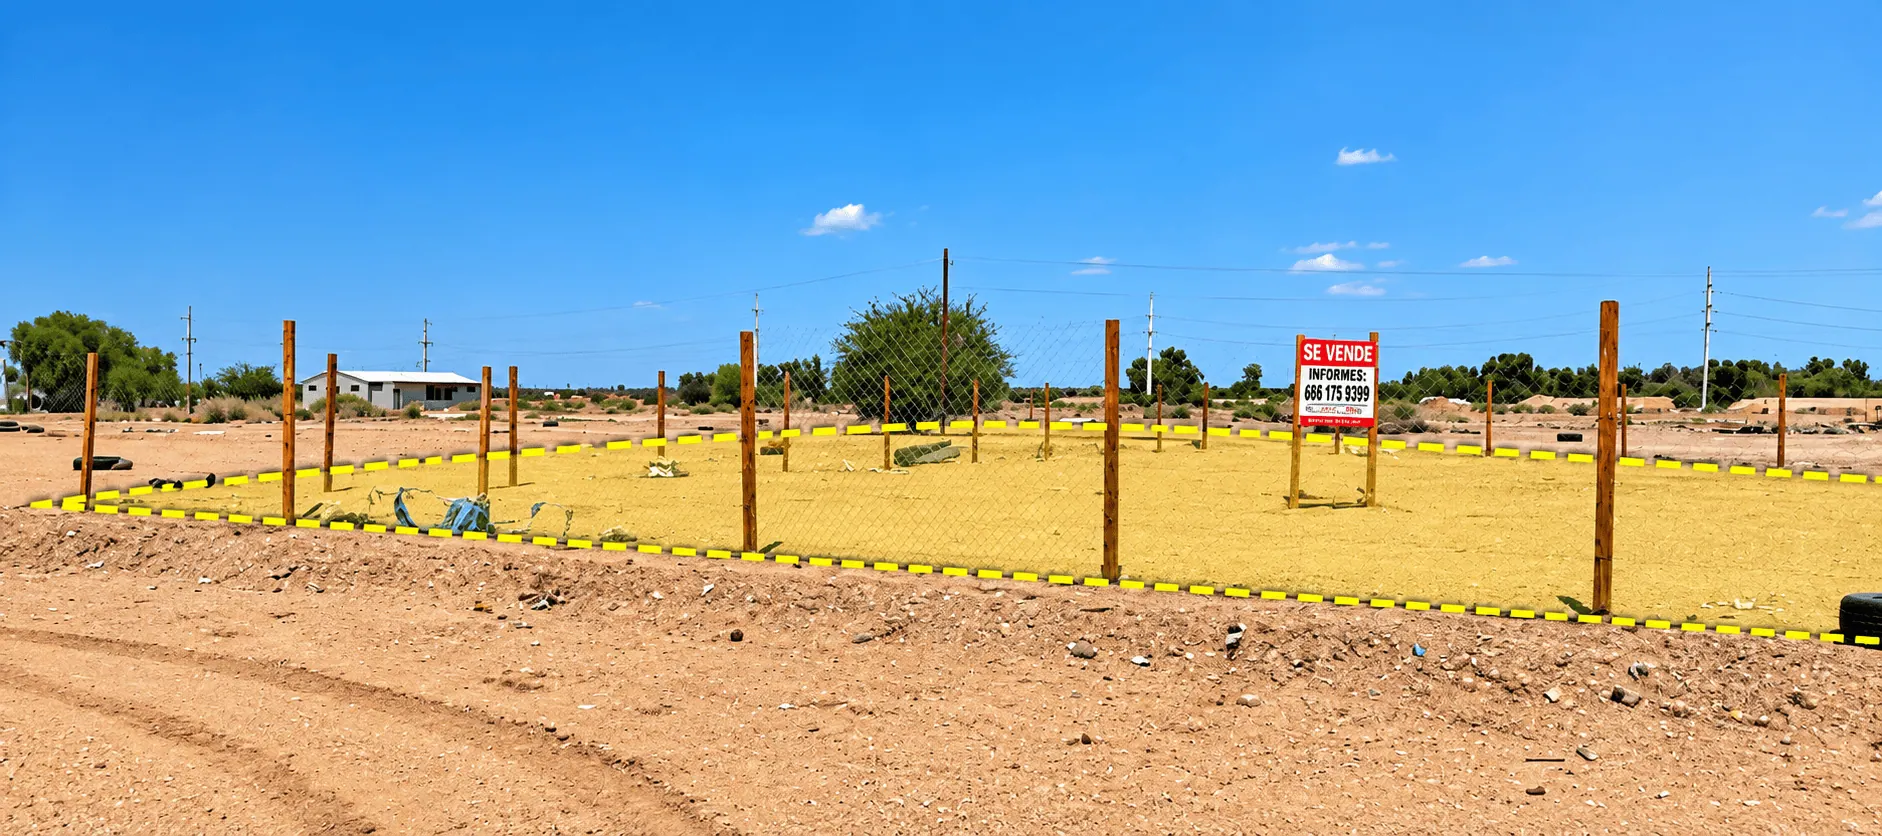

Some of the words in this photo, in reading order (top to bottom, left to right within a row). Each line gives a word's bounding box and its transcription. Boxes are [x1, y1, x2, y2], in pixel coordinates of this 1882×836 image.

[1303, 343, 1321, 361] SE
[1325, 344, 1373, 362] VENDE
[1309, 368, 1367, 382] INFORMES:
[1304, 384, 1322, 401] 686
[1325, 385, 1342, 401] 175
[1345, 385, 1370, 402] 9399
